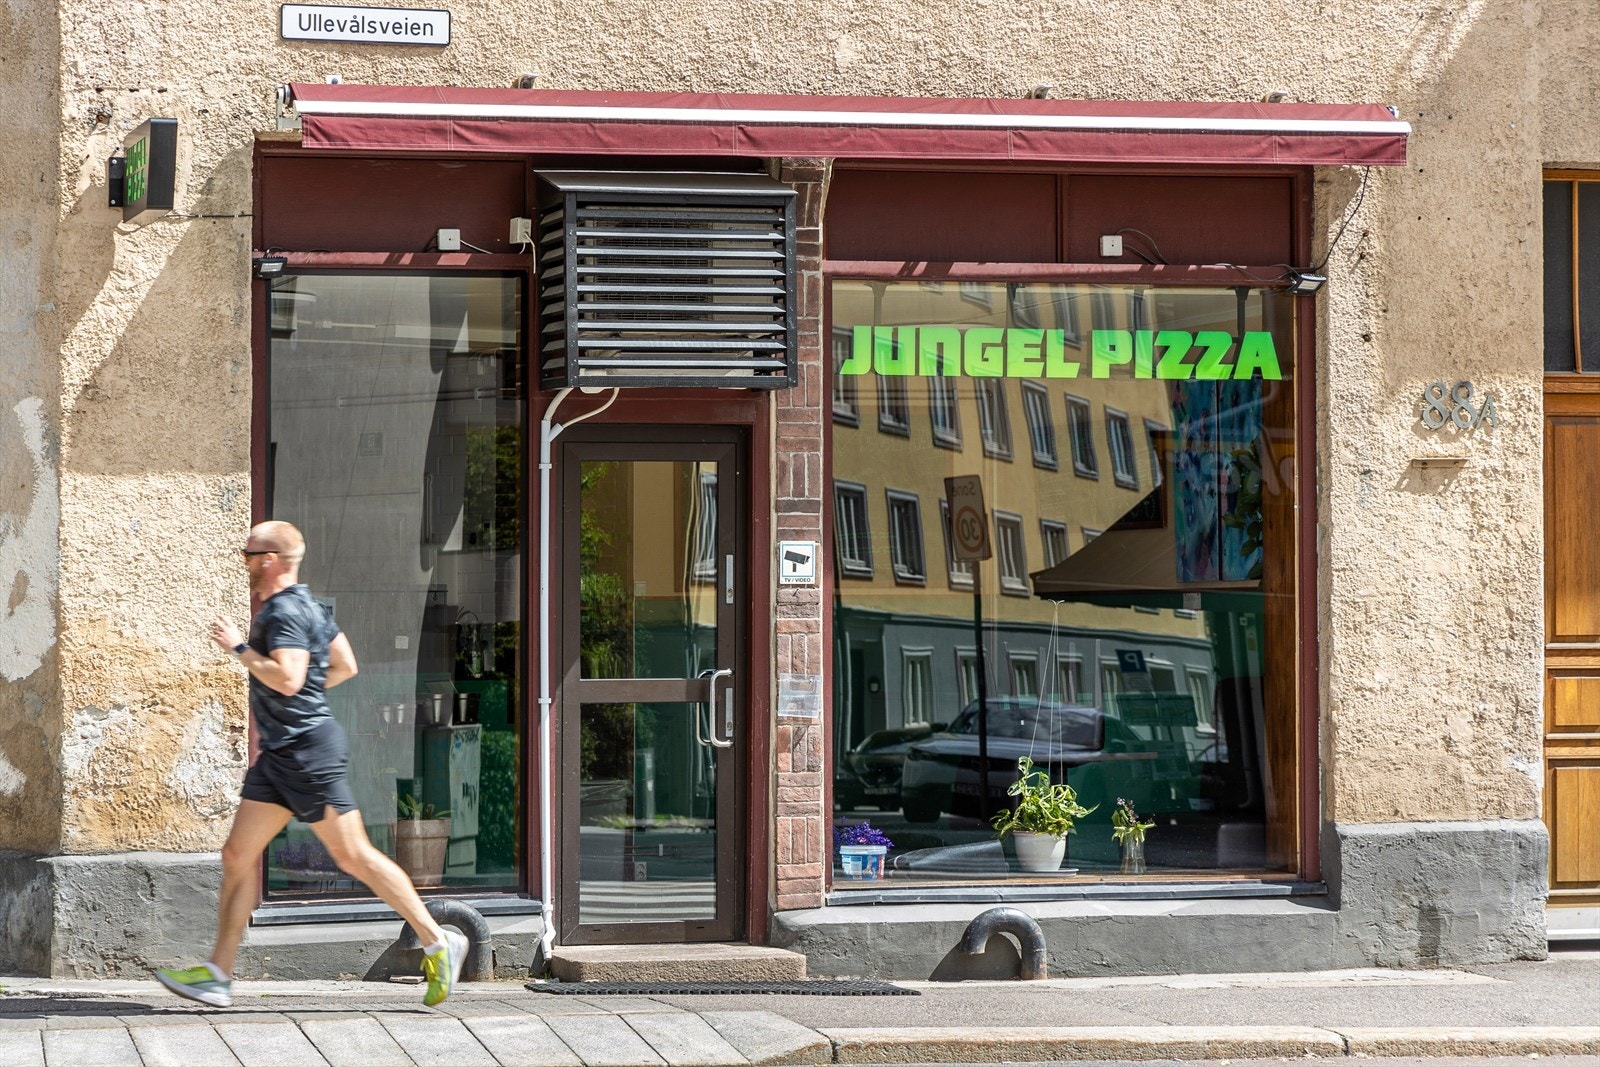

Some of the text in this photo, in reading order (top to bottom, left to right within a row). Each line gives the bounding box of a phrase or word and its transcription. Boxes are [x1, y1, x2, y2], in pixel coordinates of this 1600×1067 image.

[298, 13, 434, 36] Ullevålsveien
[839, 325, 1282, 380] JUNGEL PIZZA
[1422, 380, 1498, 429] 88A
